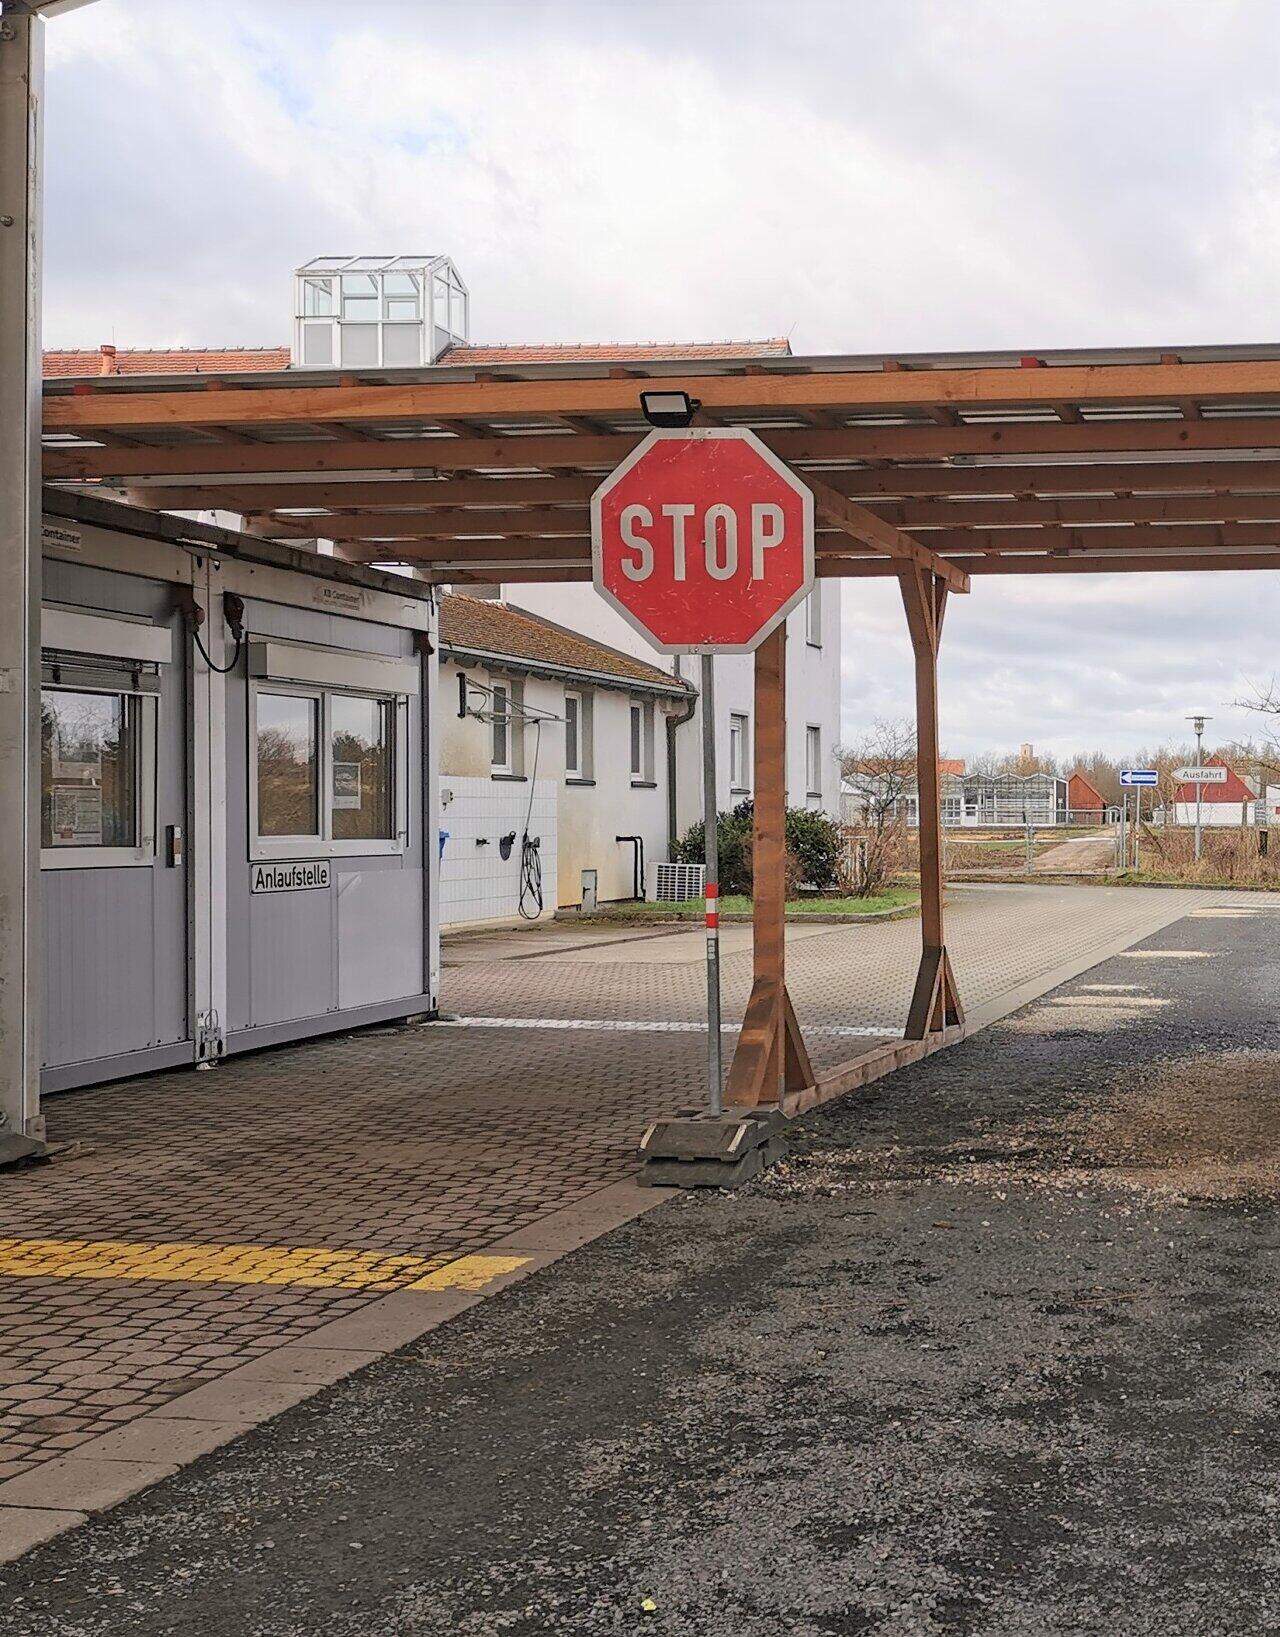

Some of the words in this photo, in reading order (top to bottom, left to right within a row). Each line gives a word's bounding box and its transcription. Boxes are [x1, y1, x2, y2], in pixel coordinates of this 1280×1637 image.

[620, 503, 785, 582] STOP
[1182, 770, 1222, 779] Ausfahrt
[255, 864, 328, 890] Anlaufstelle
